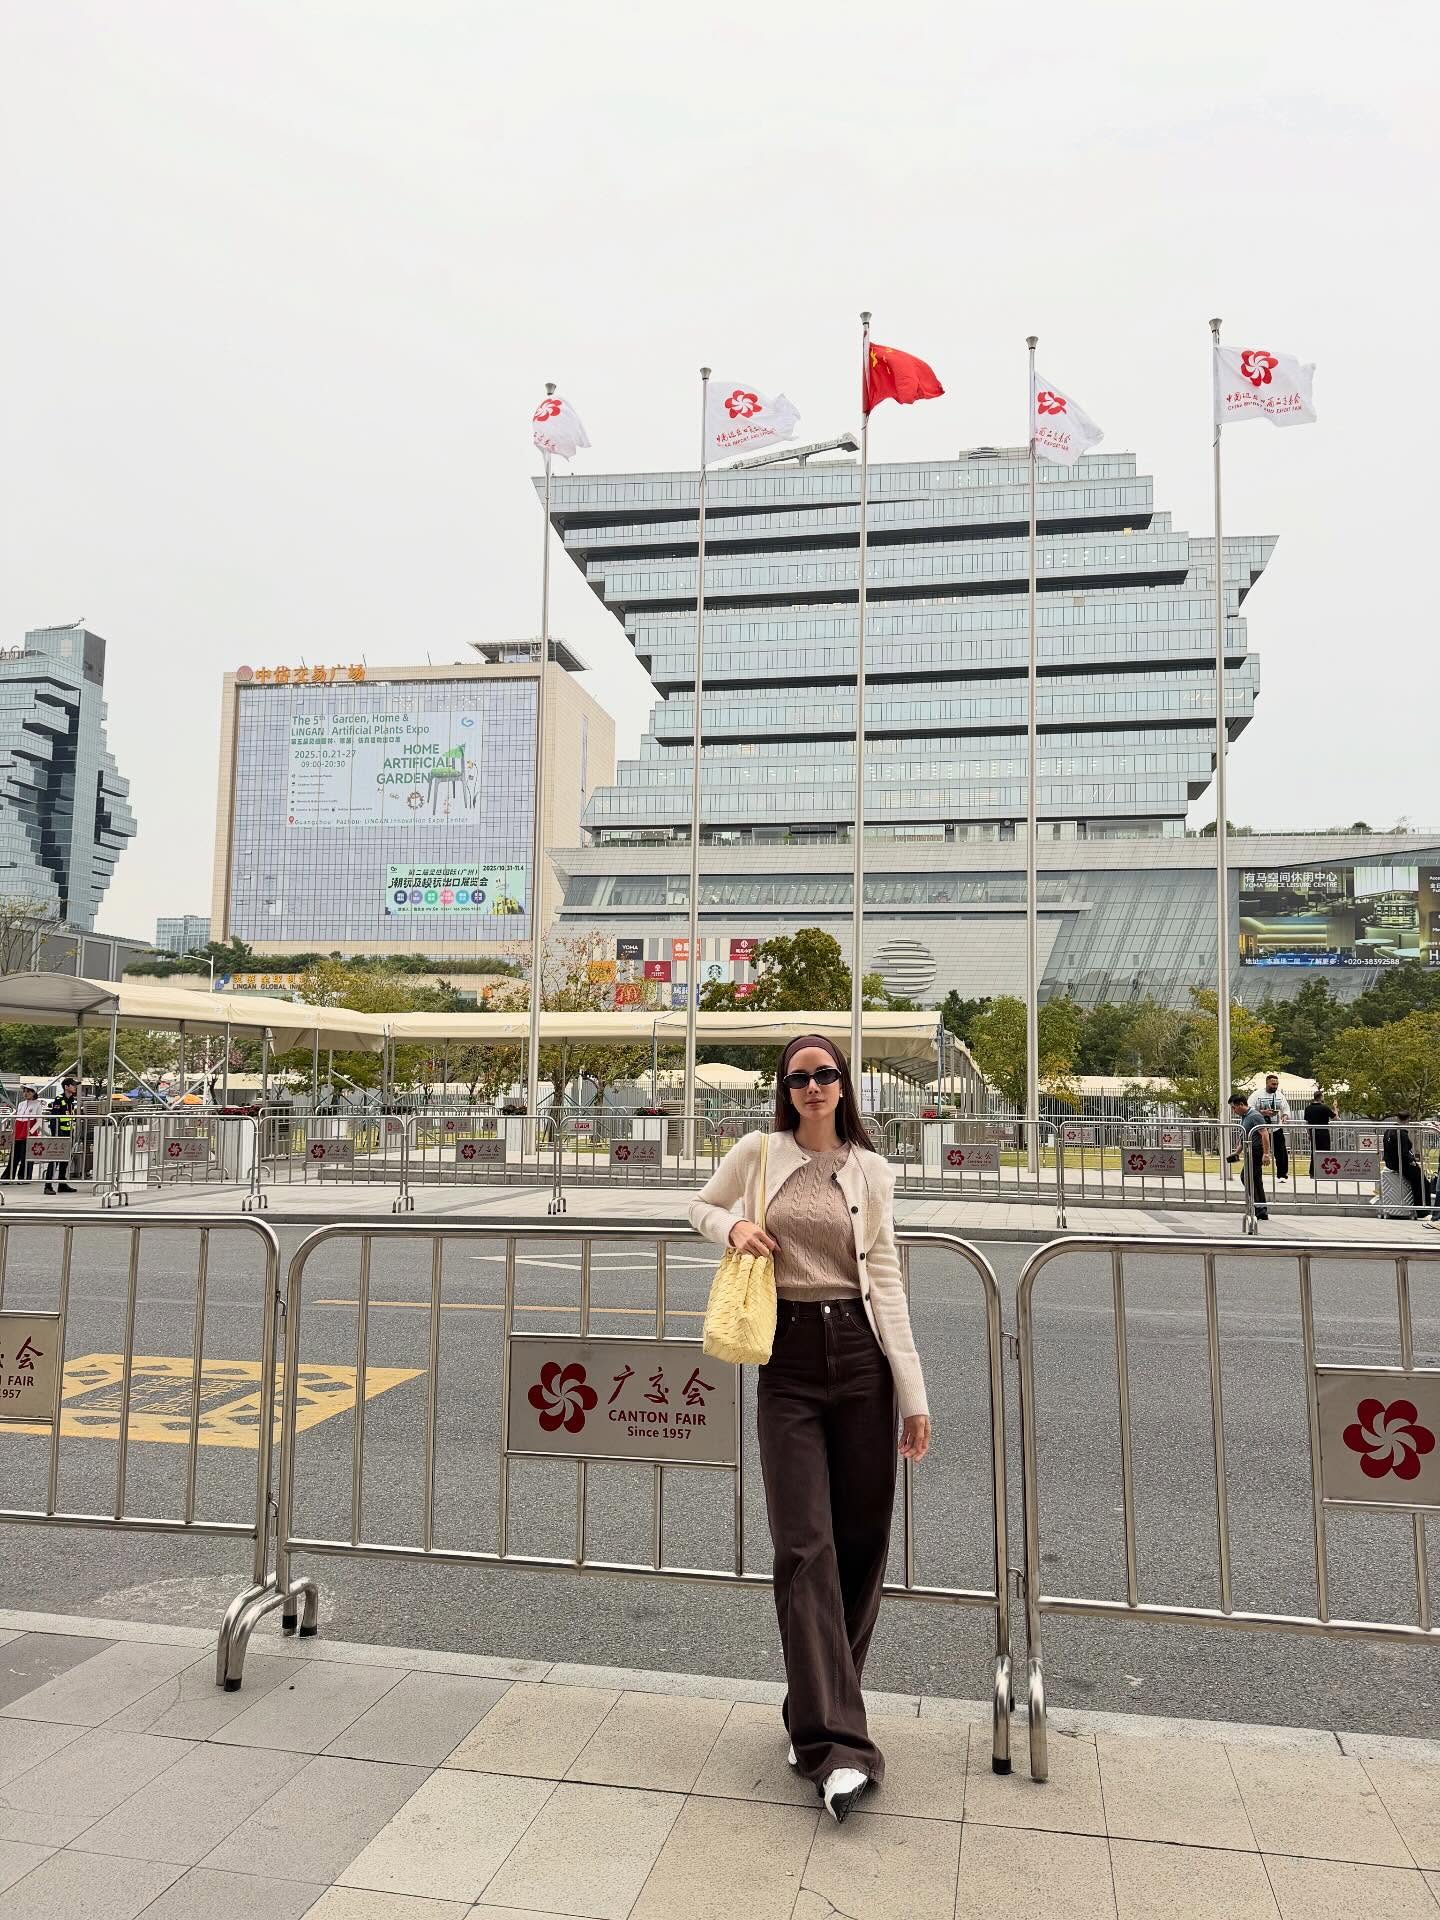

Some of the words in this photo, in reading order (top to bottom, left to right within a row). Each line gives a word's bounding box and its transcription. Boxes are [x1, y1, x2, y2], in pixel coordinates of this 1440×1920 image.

[292, 716, 310, 725] The
[372, 714, 400, 723] Home
[402, 713, 409, 722] &
[291, 727, 324, 736] LINGAN
[332, 725, 371, 735] Artificial
[374, 725, 403, 734] Plants
[406, 725, 430, 736] Expo
[294, 750, 356, 759] 2025.10.21-27
[403, 744, 439, 755] HOME
[301, 760, 345, 768] 09:00-20:30
[384, 757, 452, 769] ARTIFICIAL
[376, 772, 430, 785] GARDEN
[1244, 872, 1338, 882] 有马空间休闲中心
[8, 1376, 34, 1387] FAIR
[607, 1364, 716, 1407] 广交会
[608, 1409, 669, 1424] CANTON
[675, 1412, 707, 1426] FAIR
[627, 1425, 660, 1438] Since
[662, 1427, 692, 1440] 1957
